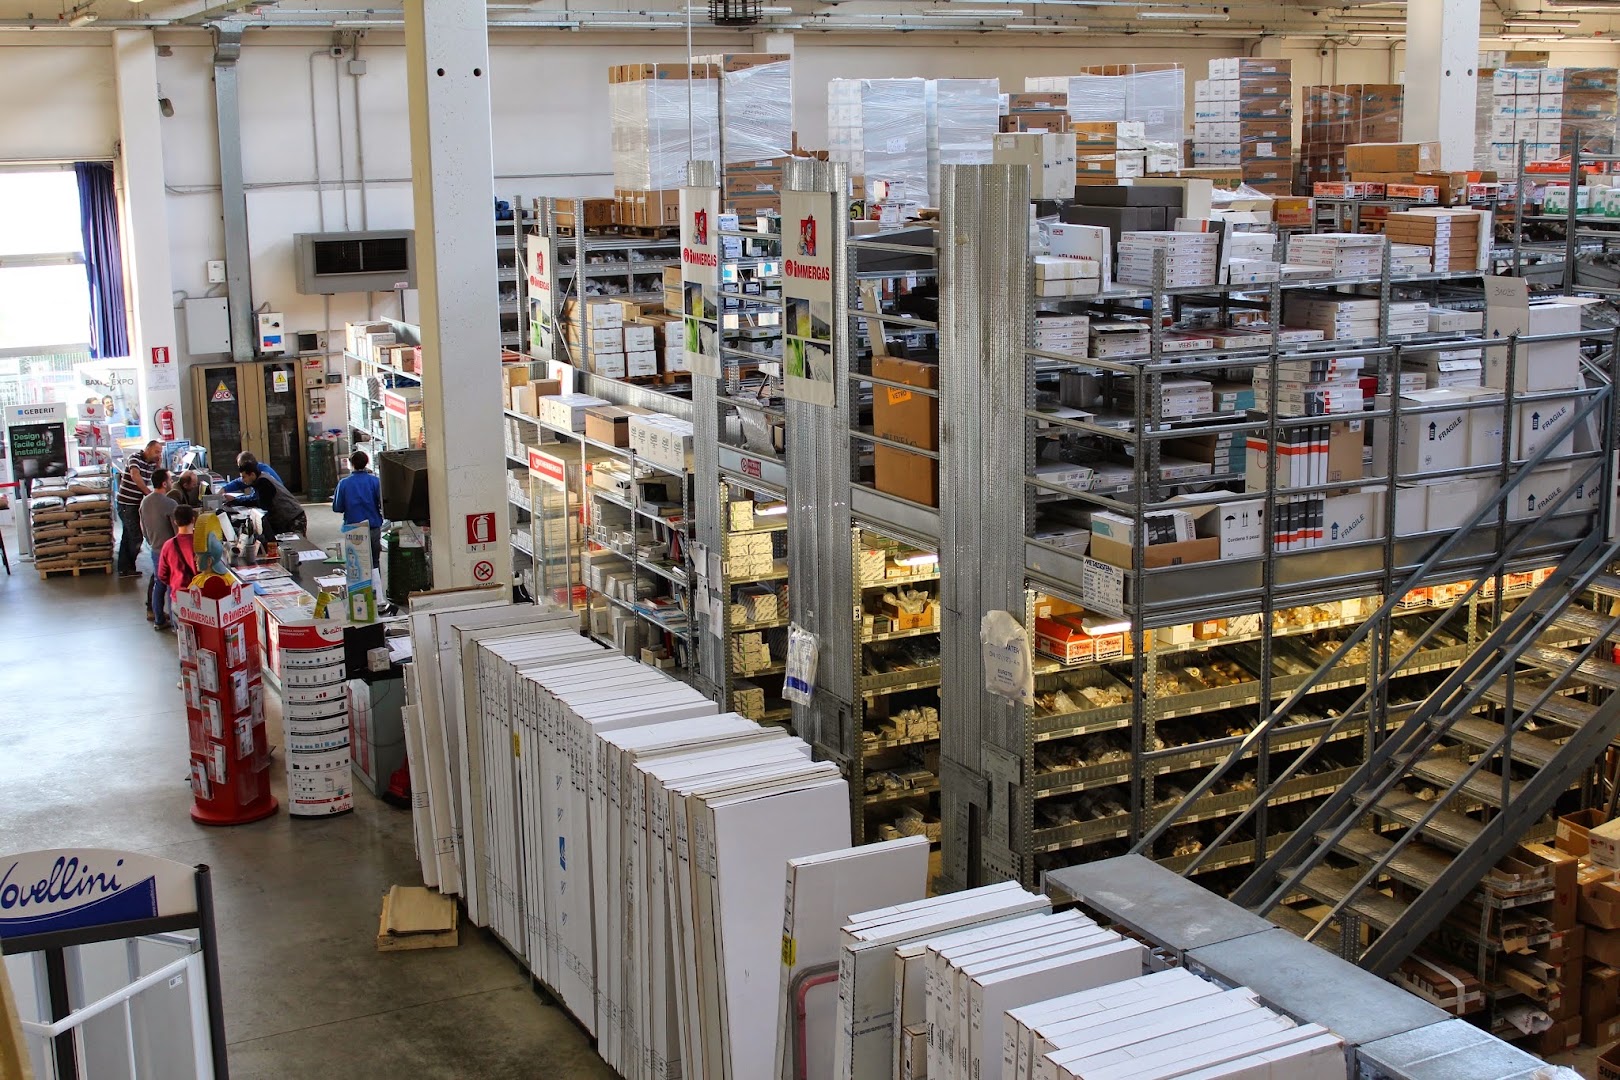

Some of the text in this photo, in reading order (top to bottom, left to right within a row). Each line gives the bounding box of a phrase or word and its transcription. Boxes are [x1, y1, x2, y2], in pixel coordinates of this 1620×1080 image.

[24, 407, 55, 415] GEBERIT
[1541, 406, 1567, 431] FRAGILE
[13, 432, 41, 442] Design
[1437, 416, 1463, 441] FRAGILE
[13, 440, 35, 449] facile
[1537, 486, 1563, 510] FRAGILE
[1340, 513, 1365, 539] FRAGILE
